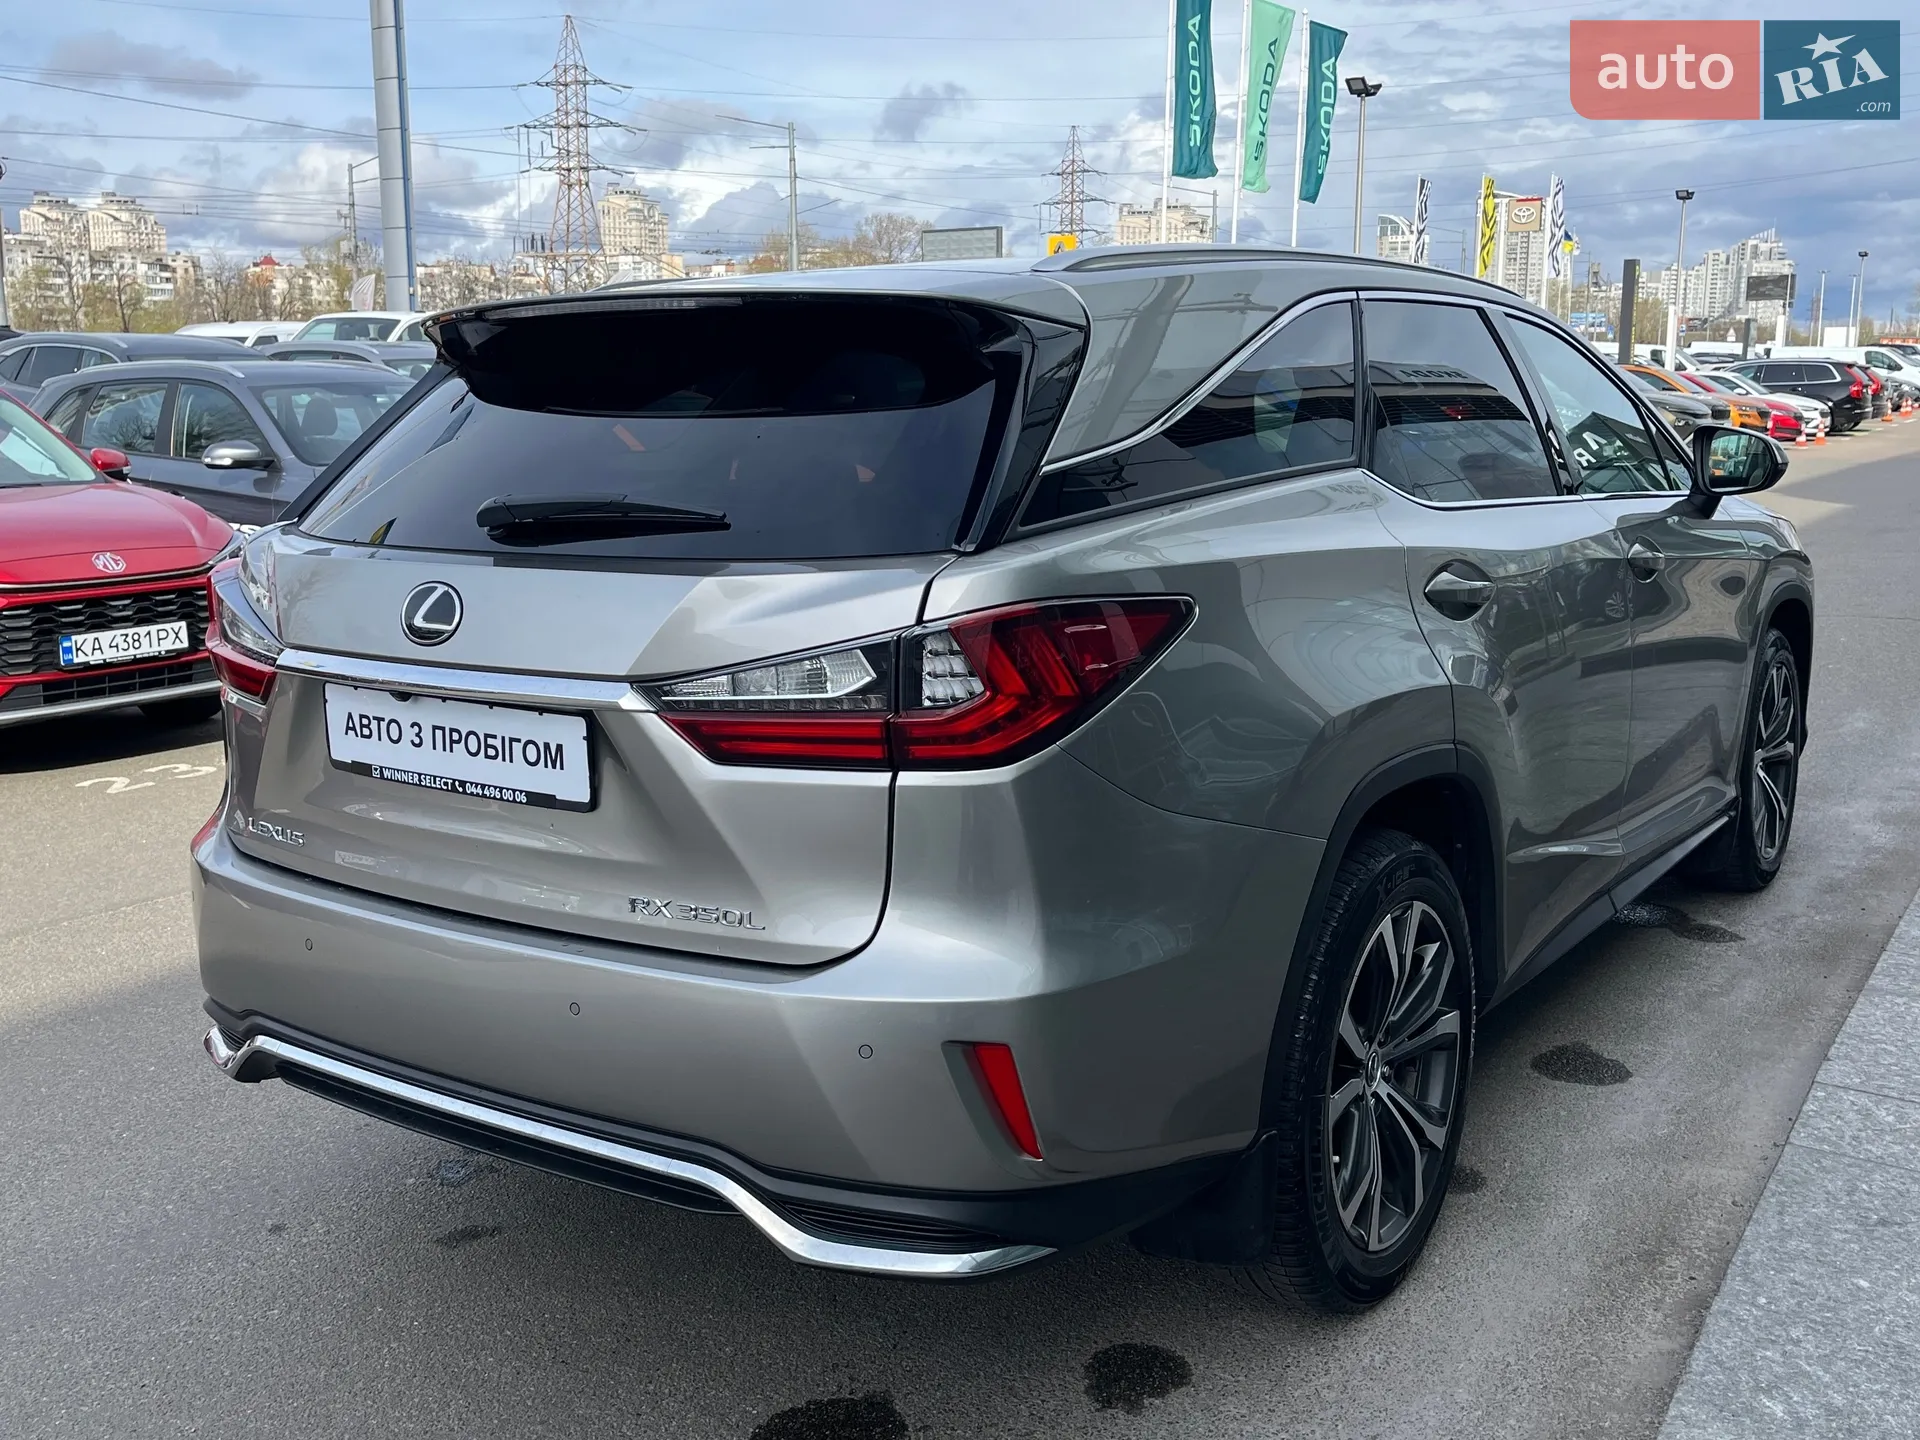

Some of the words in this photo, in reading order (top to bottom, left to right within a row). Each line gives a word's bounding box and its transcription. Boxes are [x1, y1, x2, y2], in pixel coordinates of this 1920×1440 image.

[1187, 13, 1201, 148] SKODA
[1254, 37, 1279, 161] SKODA
[1317, 56, 1336, 175] SKODA
[74, 636, 104, 659] KA
[108, 630, 152, 653] 4381
[156, 625, 184, 648] PX
[344, 711, 403, 745] АВТО
[409, 721, 424, 748] З
[431, 724, 565, 771] ПРОБІГОМ
[382, 767, 419, 785] WINNER
[420, 774, 453, 791] SELECT
[465, 782, 483, 795] 044
[483, 785, 500, 799] 496
[502, 788, 514, 801] 00
[514, 790, 527, 803] 06
[248, 816, 305, 847] LEXUS
[627, 895, 674, 919] RX
[675, 902, 766, 931] 350L
